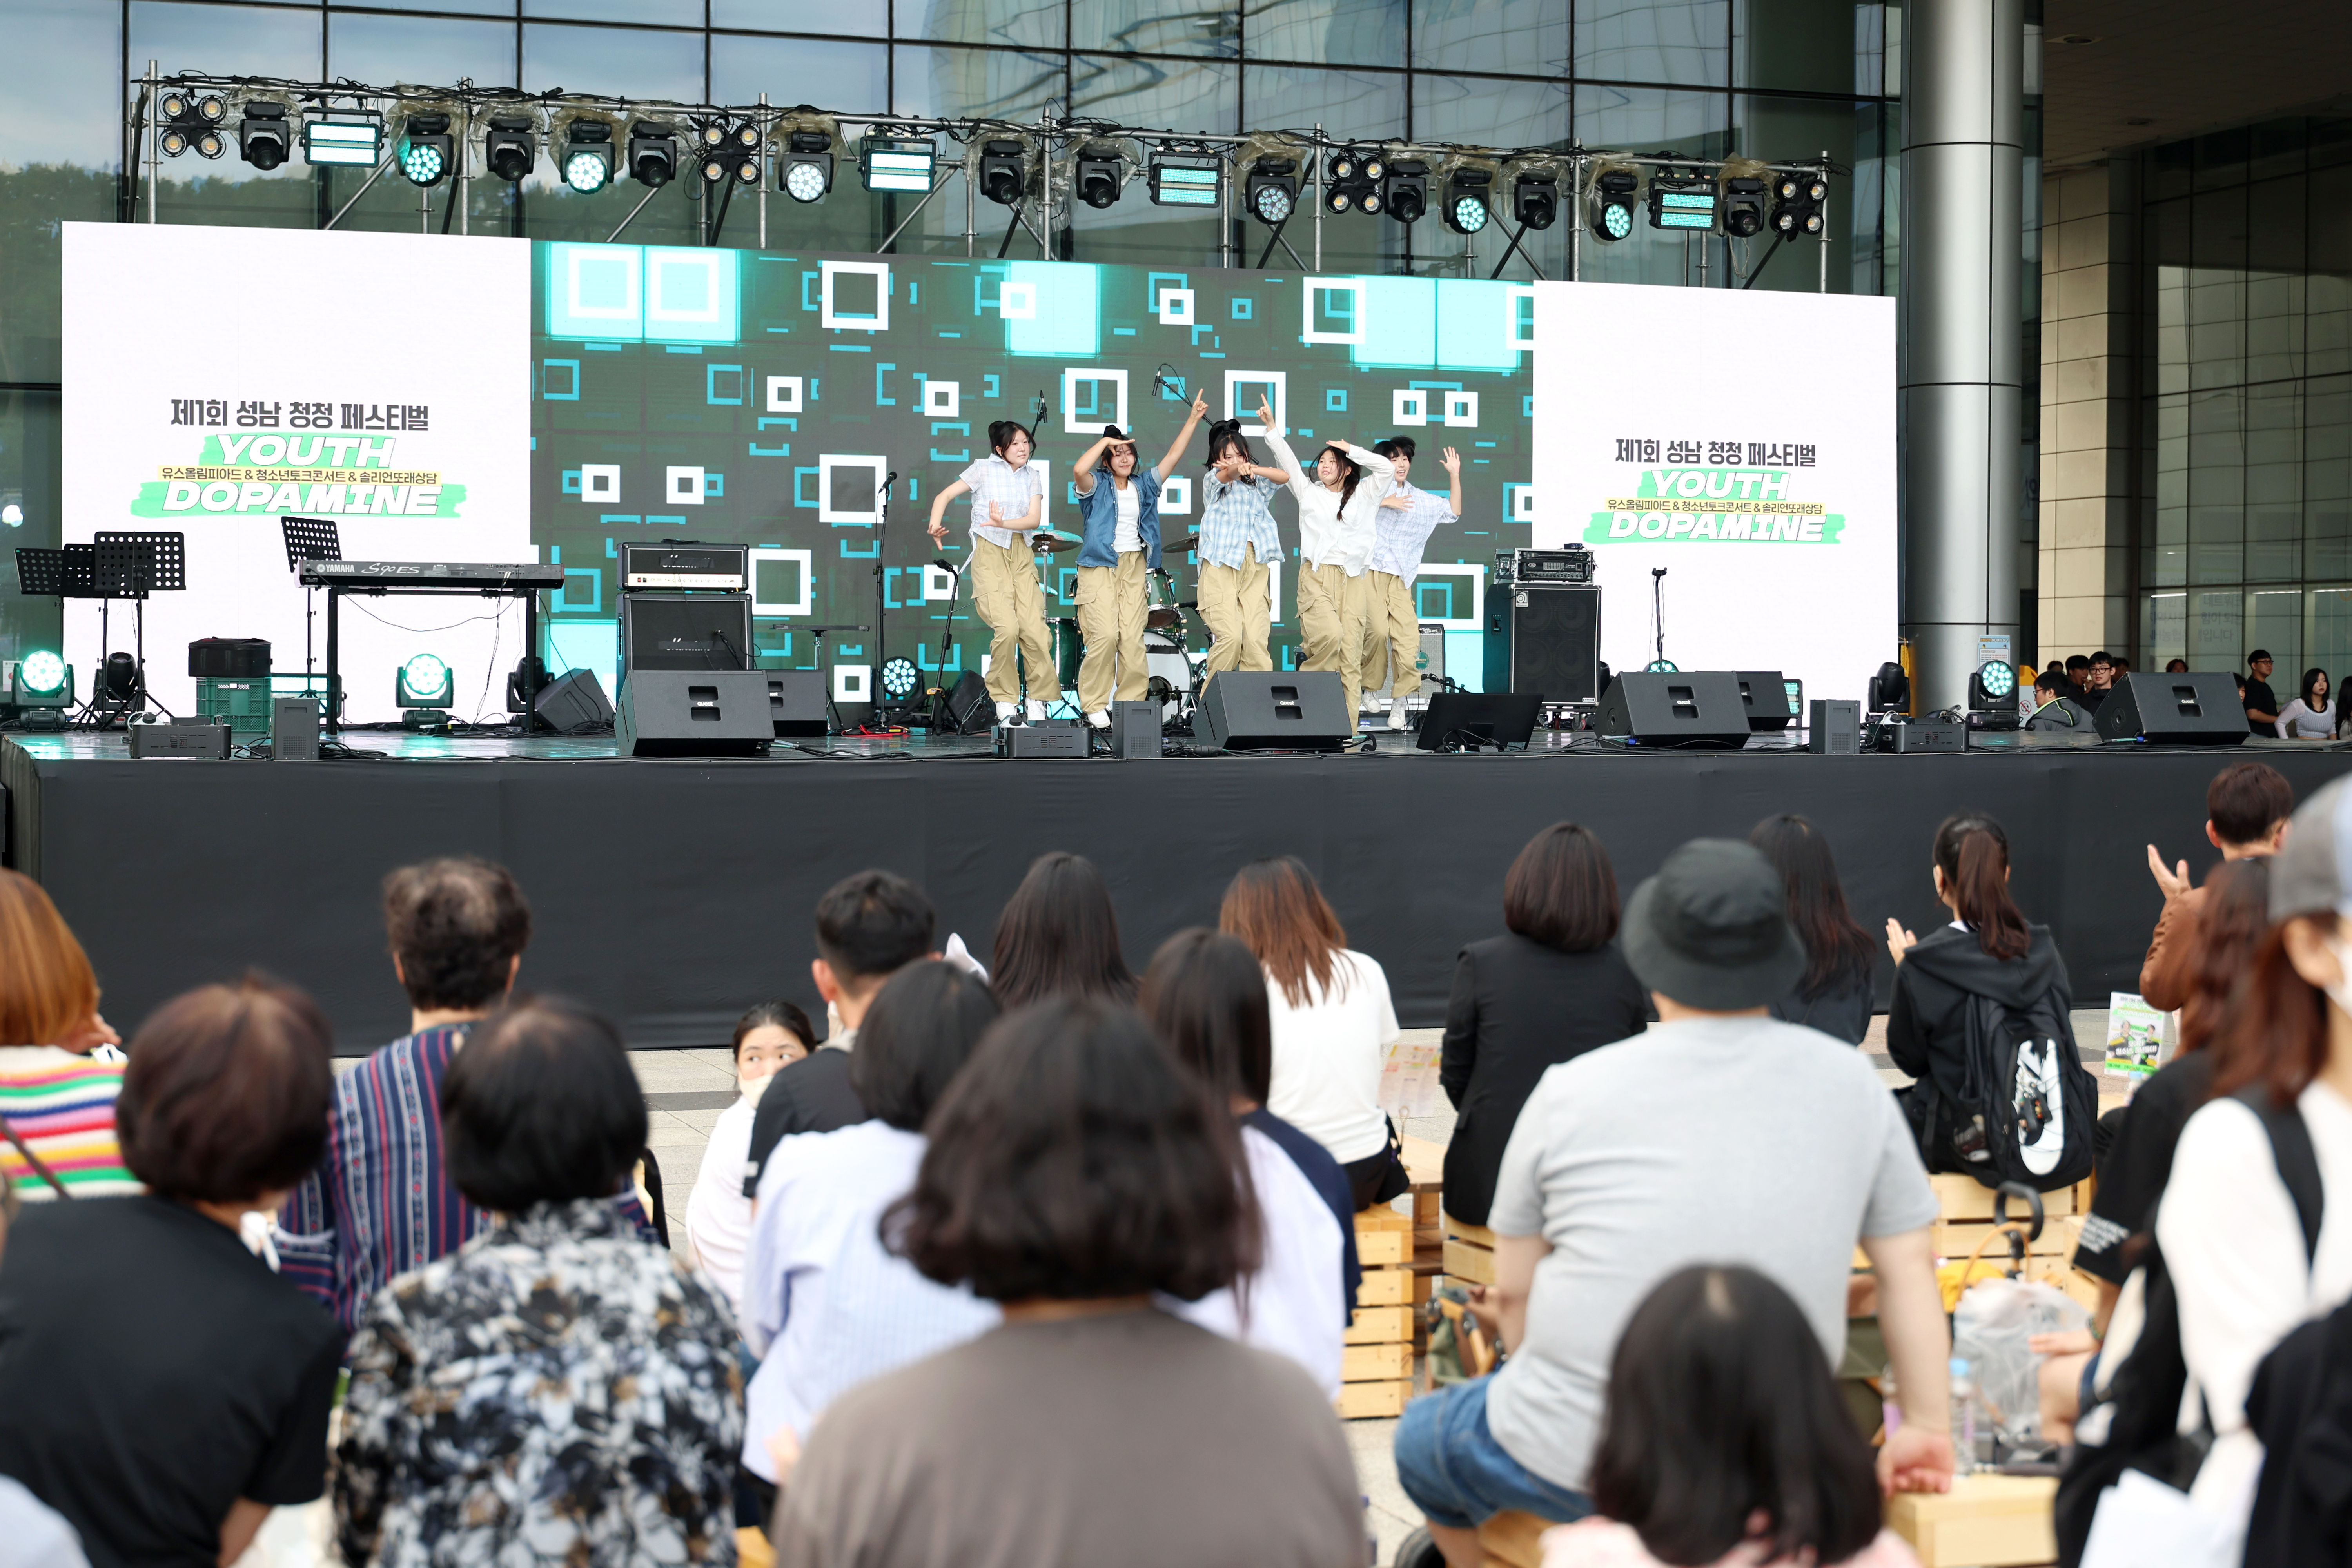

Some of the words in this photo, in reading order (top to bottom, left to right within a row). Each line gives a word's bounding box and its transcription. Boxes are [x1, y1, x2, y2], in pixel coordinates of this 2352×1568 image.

[171, 399, 227, 426] 제1회
[236, 401, 281, 427] 성남
[289, 402, 333, 428] 청청
[341, 403, 428, 431] 페스티벌
[216, 434, 396, 468] YOUTH
[1615, 439, 1660, 463] 제1회
[1667, 440, 1702, 464] 성남
[1708, 441, 1742, 465] 청청
[1748, 443, 1815, 467] 페스티벌
[162, 468, 241, 480] 유스올림피아드
[245, 470, 253, 480] &
[256, 469, 345, 482] 청소년토크콘서트
[348, 472, 357, 482] &
[360, 472, 437, 484] 솔리언또래상담
[1651, 470, 1791, 500] YOUTH
[162, 481, 443, 515] DOPAMINE
[1608, 499, 1671, 510] 유스올림피아드
[1673, 501, 1679, 510] &
[1682, 501, 1751, 512] 청소년토크콘서트
[1754, 503, 1760, 512] &
[1762, 503, 1822, 514] 솔리언또래상담
[1608, 511, 1827, 541] DOPAMINE
[326, 564, 355, 573] YAMAHA
[2117, 1009, 2158, 1019] DOPAMINE
